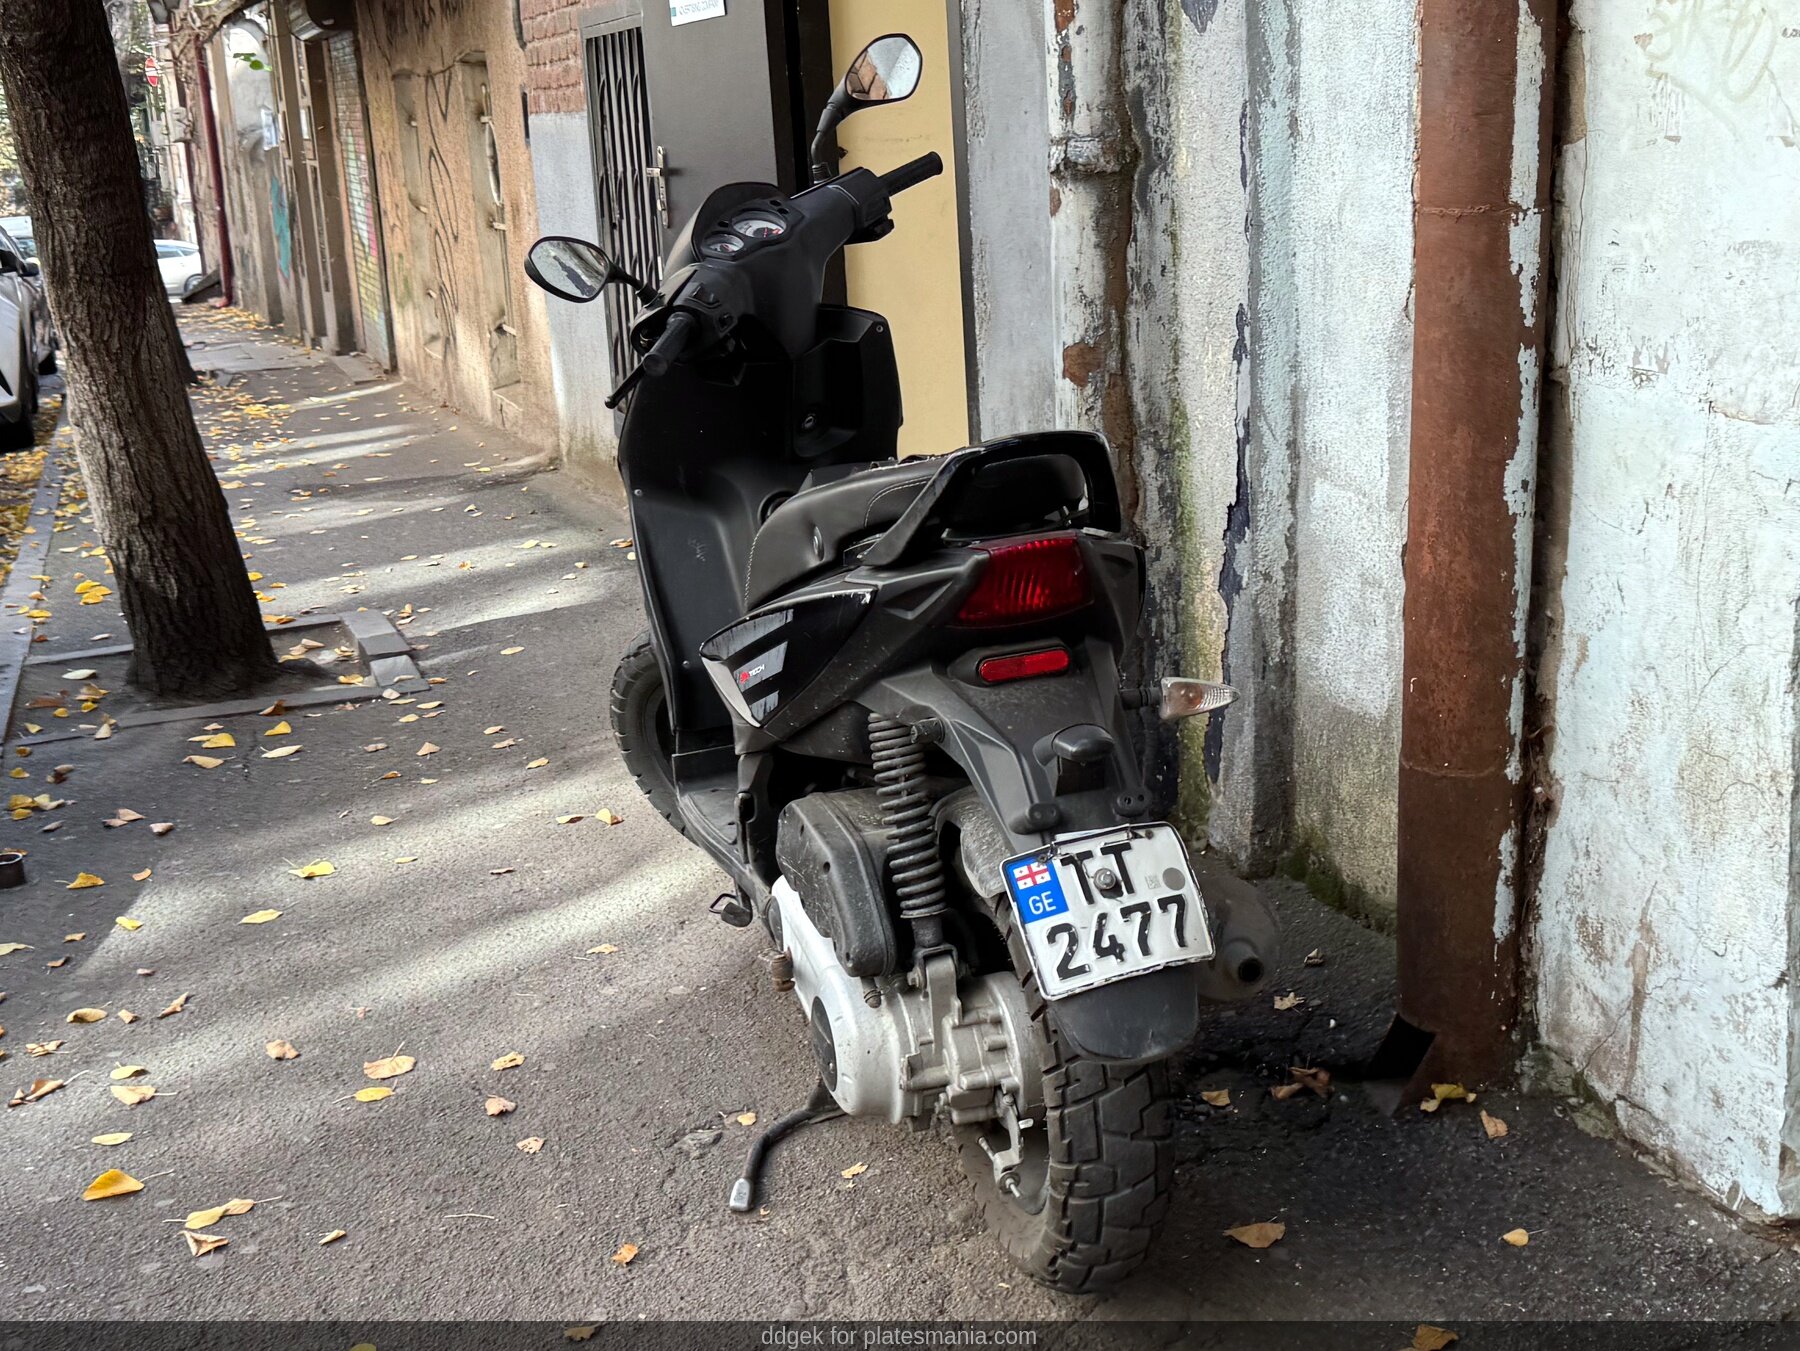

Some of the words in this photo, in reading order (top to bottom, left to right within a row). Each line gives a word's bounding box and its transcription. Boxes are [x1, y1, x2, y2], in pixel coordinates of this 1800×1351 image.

[1028, 891, 1057, 915] GE
[1060, 841, 1135, 906] TT
[1046, 894, 1189, 981] 2477
